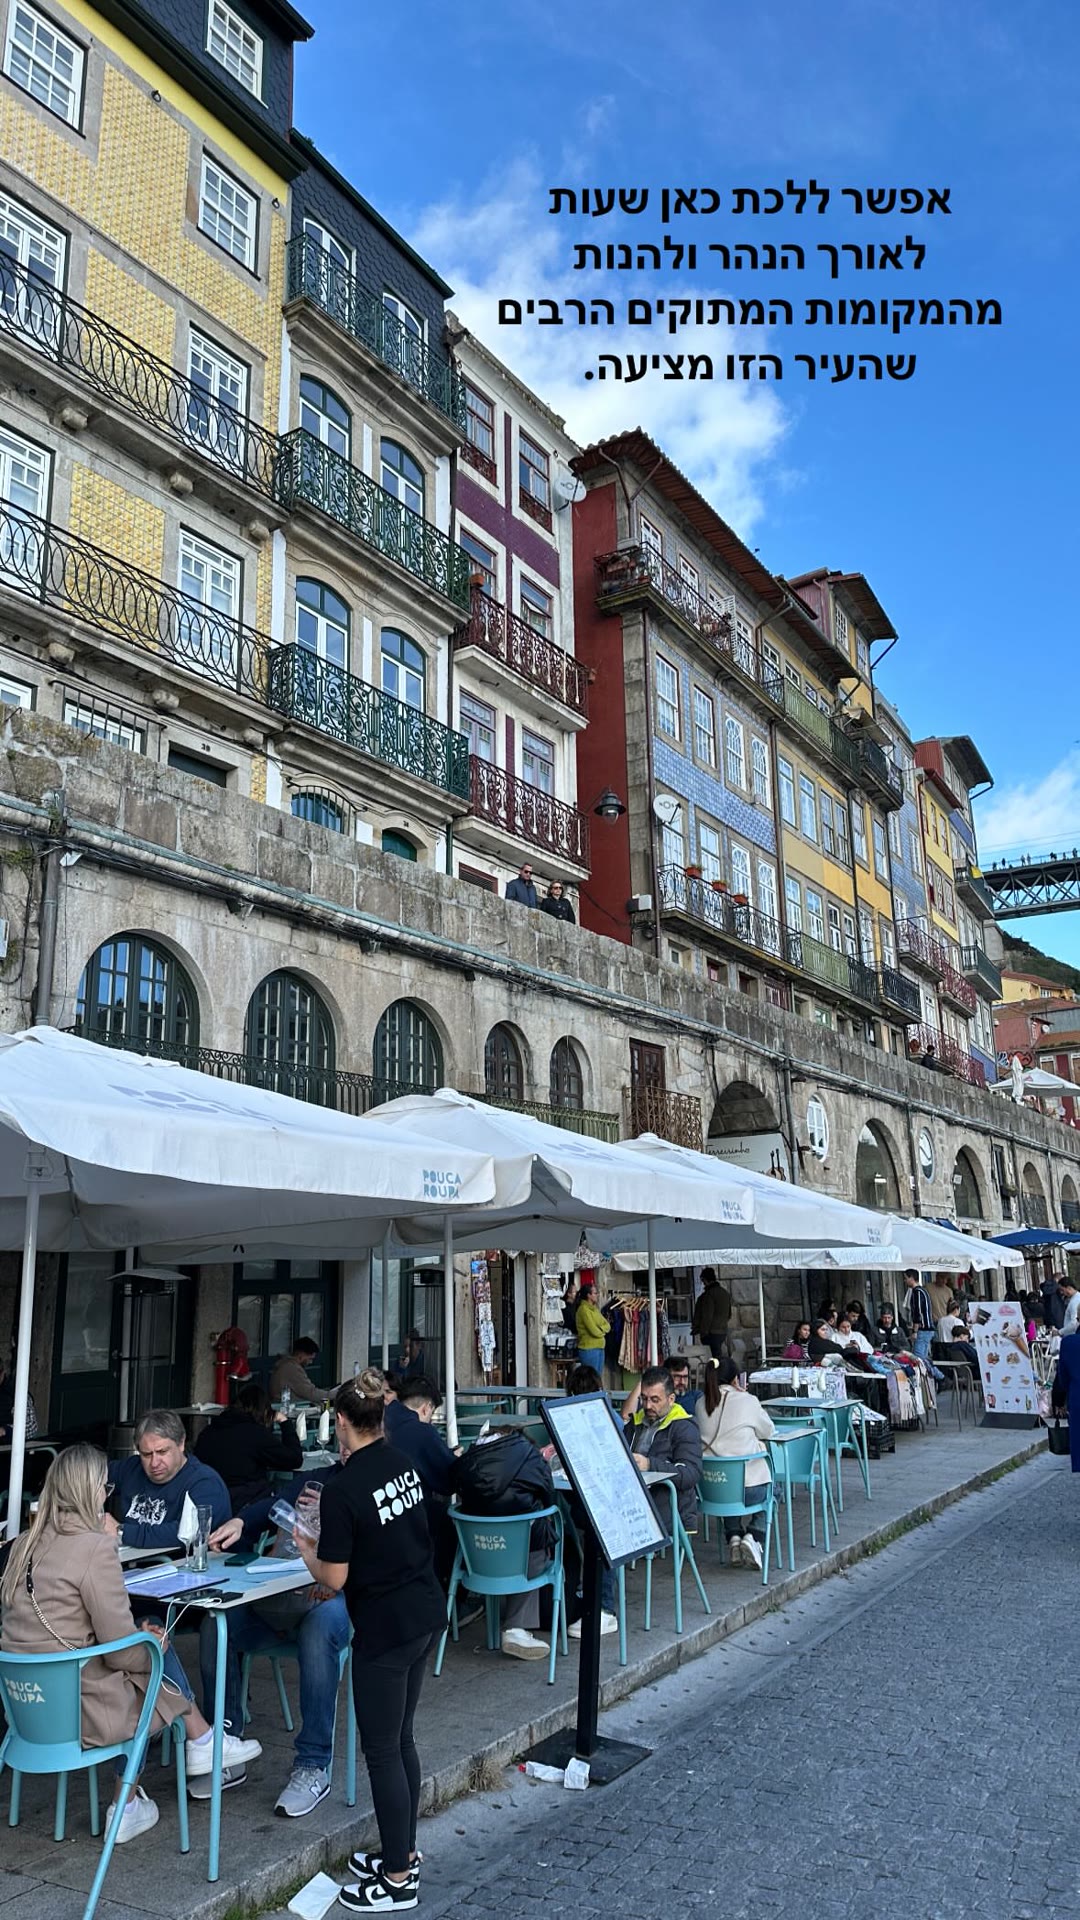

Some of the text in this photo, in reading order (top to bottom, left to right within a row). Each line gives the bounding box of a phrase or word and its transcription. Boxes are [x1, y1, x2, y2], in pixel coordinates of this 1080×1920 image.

[422, 1169, 462, 1184] POUCA
[423, 1184, 460, 1198] ROUPA
[372, 1468, 421, 1508] POUCA
[378, 1485, 424, 1525] ROUPA
